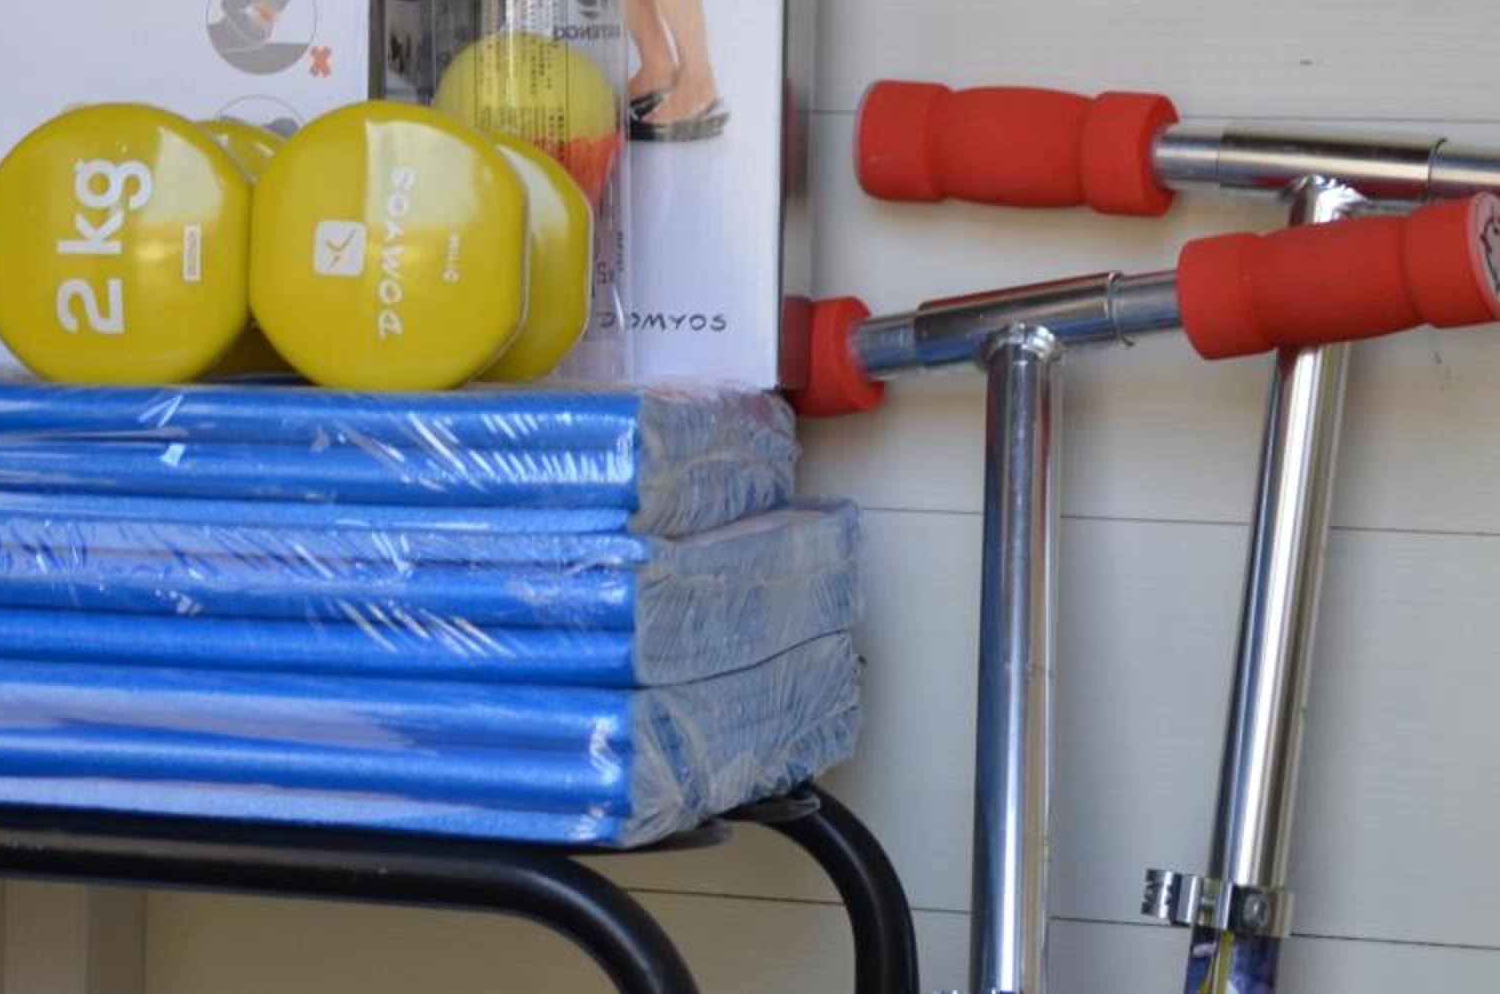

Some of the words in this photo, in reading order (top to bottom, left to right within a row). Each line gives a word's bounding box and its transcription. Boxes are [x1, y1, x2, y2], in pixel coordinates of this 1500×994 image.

[56, 158, 155, 255] kg
[376, 165, 417, 341] DOMYOS
[56, 277, 126, 335] 2
